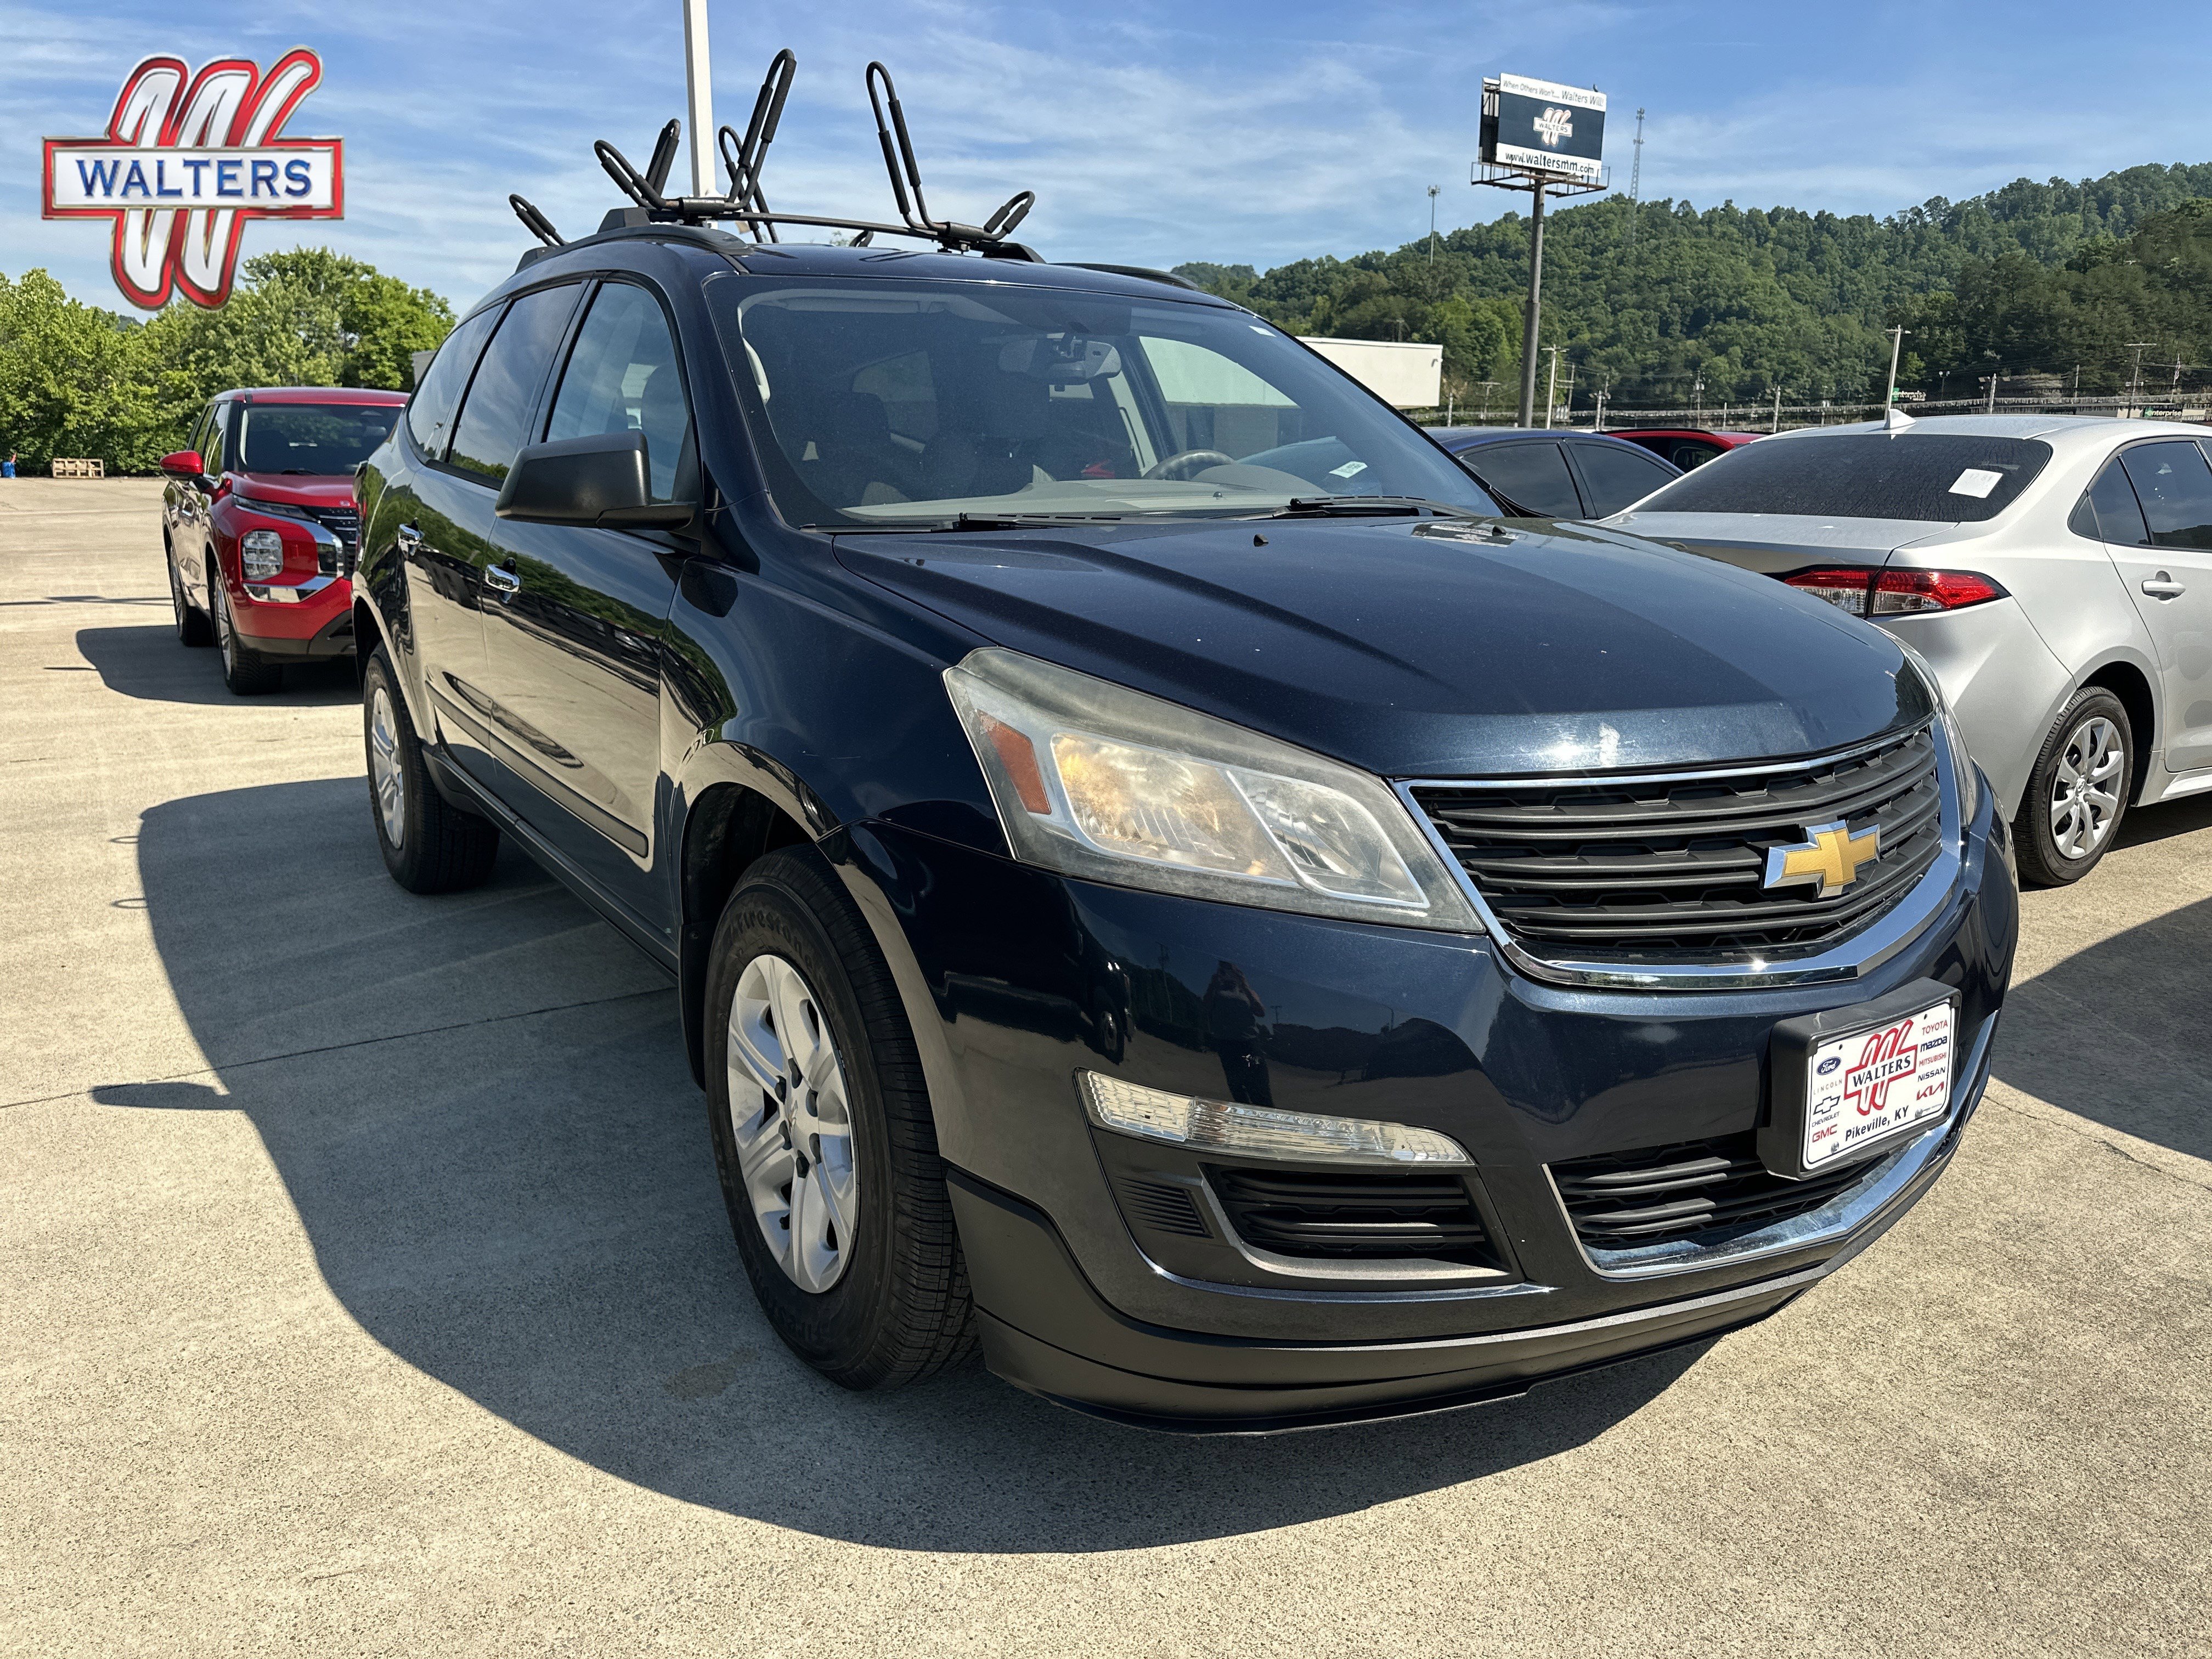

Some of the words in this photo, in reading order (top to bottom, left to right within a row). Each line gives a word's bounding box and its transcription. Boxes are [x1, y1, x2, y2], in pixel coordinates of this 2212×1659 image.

[1503, 80, 1519, 89] When
[1520, 83, 1538, 94] Others
[1561, 90, 1588, 104] Walters
[1539, 122, 1568, 133] WALTERS
[2147, 409, 2182, 417] enterprise
[1922, 1019, 1948, 1035] TOYOTA
[1821, 1060, 1837, 1073] Ford
[1919, 1051, 1947, 1067] MITSUBISHI
[1853, 1055, 1911, 1087] WALTERS
[1918, 1066, 1946, 1082] NISSAN
[1813, 1079, 1842, 1095] LINCOLN
[1812, 1111, 1840, 1127] CHEVROLET
[1845, 1115, 1891, 1142] Pikeville,
[1894, 1105, 1909, 1121] KY
[1812, 1124, 1838, 1143] GMC
